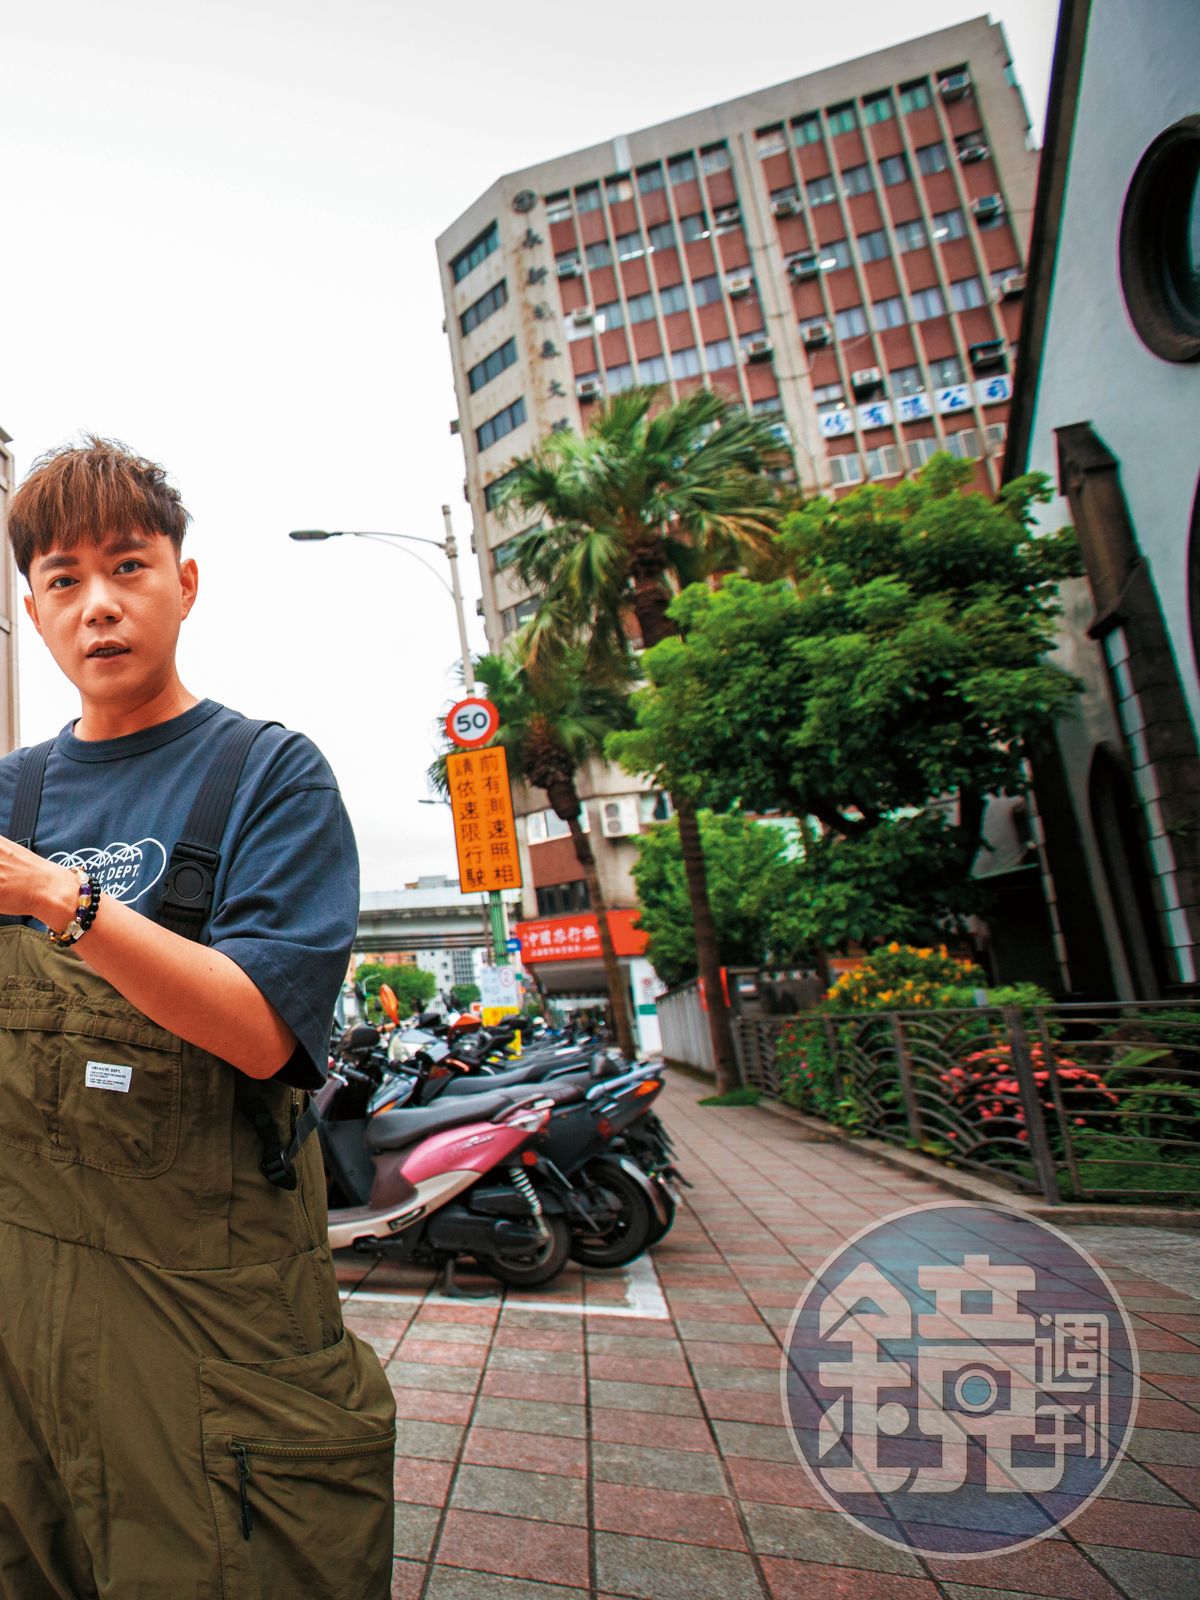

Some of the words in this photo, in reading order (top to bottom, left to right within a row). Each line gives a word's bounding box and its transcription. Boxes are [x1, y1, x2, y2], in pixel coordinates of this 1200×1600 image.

[457, 711, 487, 733] 50
[455, 758, 486, 887] 請依速限行駛
[479, 754, 514, 884] 前有測速照相
[106, 863, 140, 881] DEPT.
